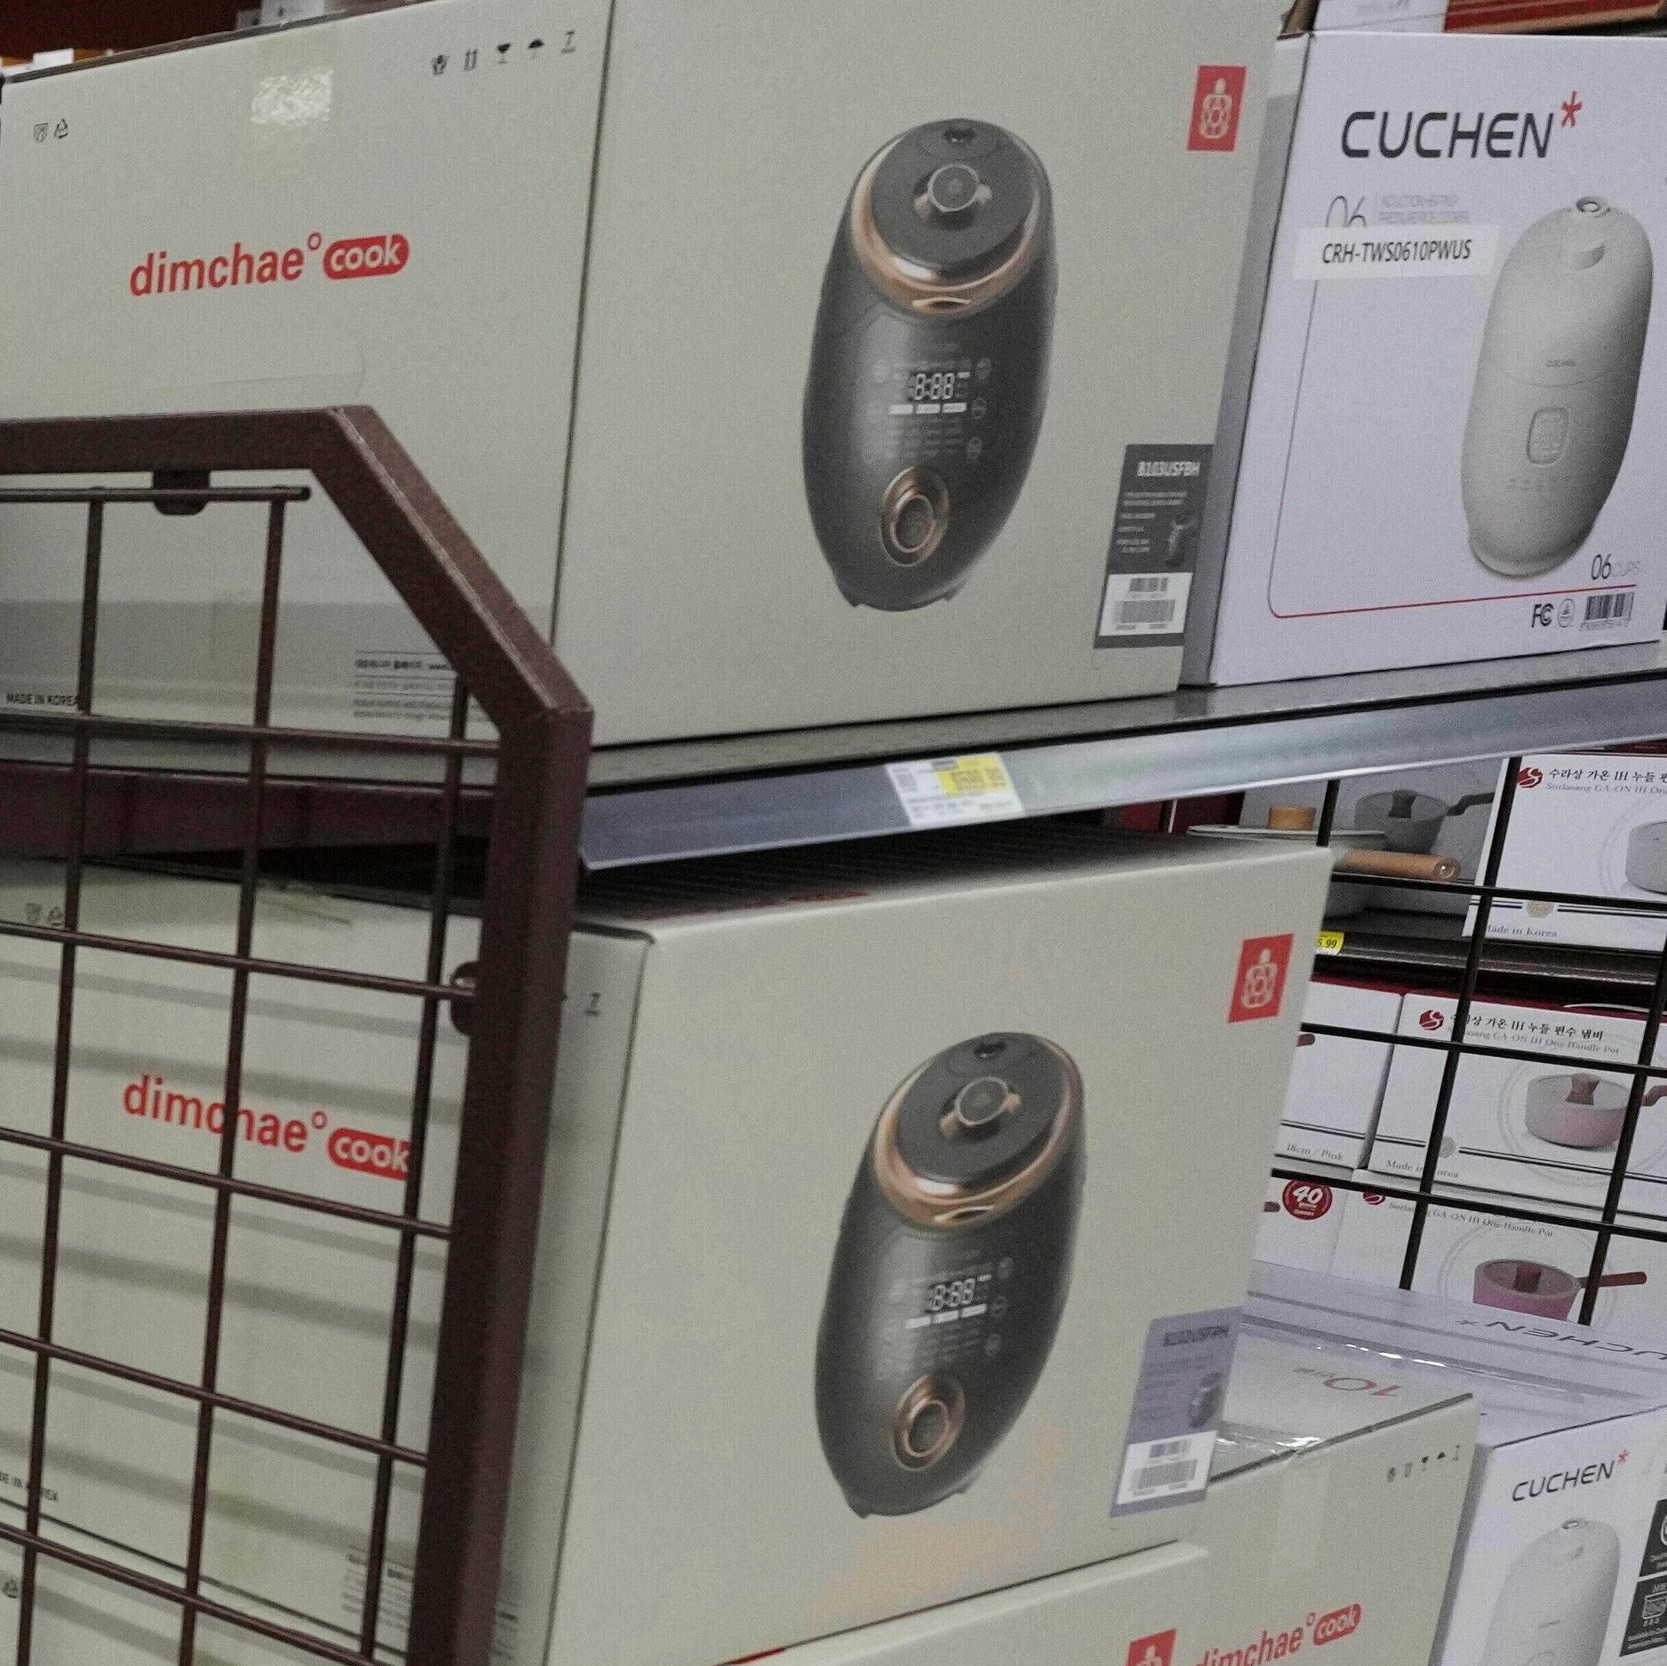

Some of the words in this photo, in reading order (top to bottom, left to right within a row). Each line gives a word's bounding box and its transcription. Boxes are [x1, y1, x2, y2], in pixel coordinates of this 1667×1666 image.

[1341, 111, 1554, 159] CUCHEN
[1322, 239, 1472, 265] CRH-TWS0610PWUS
[130, 242, 305, 296] dimchae
[329, 236, 402, 272] cook
[1526, 927, 1557, 938] Korea
[1528, 1021, 1551, 1035] 누들
[1554, 1023, 1577, 1038] 편수
[1582, 1027, 1604, 1042] 냄비
[1568, 1039, 1602, 1053] Handle
[1604, 1043, 1620, 1056] Pot
[333, 1136, 409, 1173] cook
[1320, 1147, 1344, 1162] Pink
[1291, 1183, 1325, 1204] 40
[1513, 1461, 1616, 1502] CUCHEN
